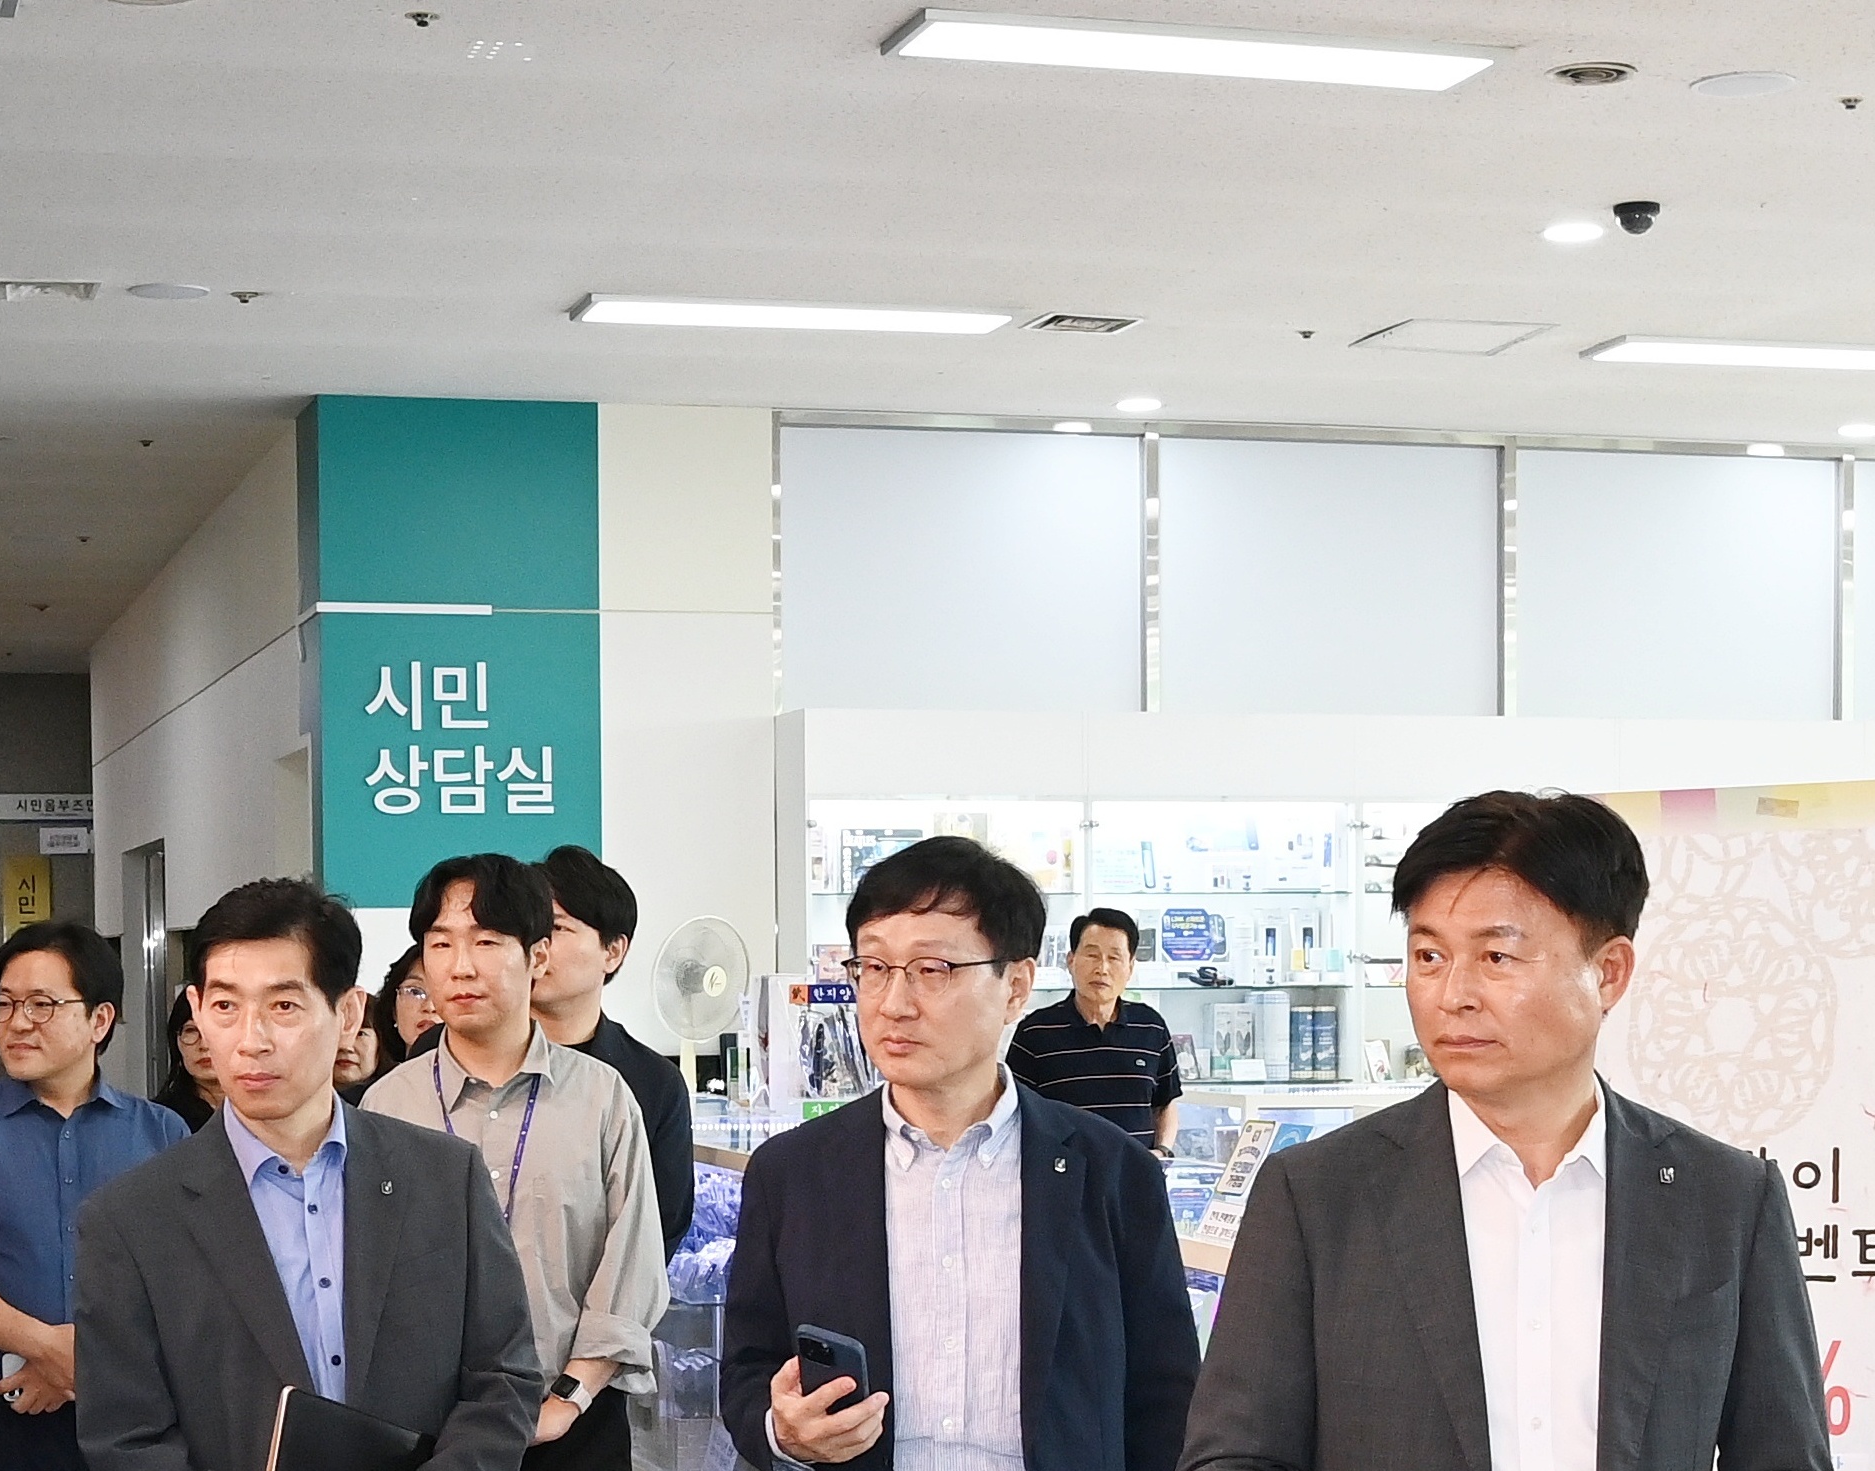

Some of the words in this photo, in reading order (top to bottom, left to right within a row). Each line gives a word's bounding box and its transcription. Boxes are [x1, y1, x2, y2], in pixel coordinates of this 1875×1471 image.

[365, 660, 489, 731] 시민
[365, 745, 555, 815] 상담실
[18, 874, 36, 925] 시민
